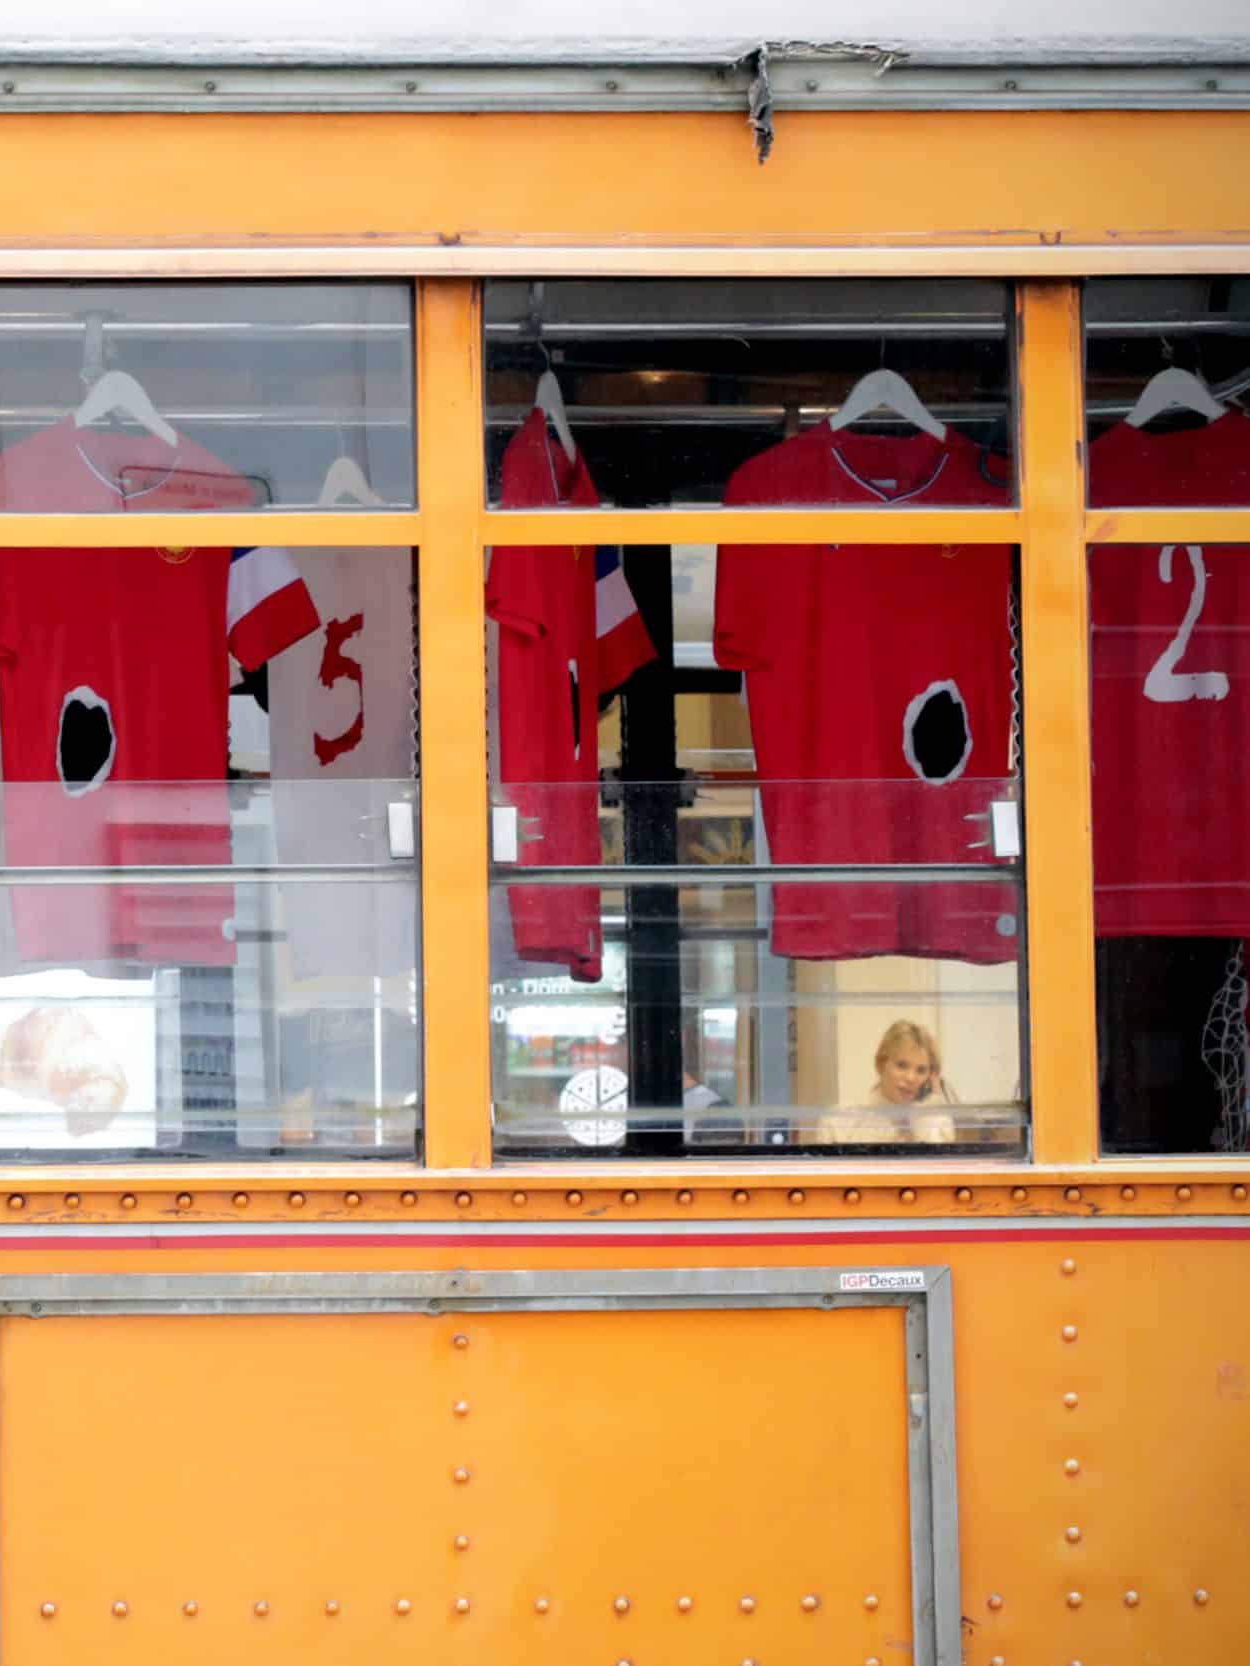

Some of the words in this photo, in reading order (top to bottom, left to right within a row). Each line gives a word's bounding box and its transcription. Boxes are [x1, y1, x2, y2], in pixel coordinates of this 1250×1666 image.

[314, 610, 364, 767] 5
[1143, 545, 1230, 702] 2
[841, 1274, 921, 1288] IGPDecaux
